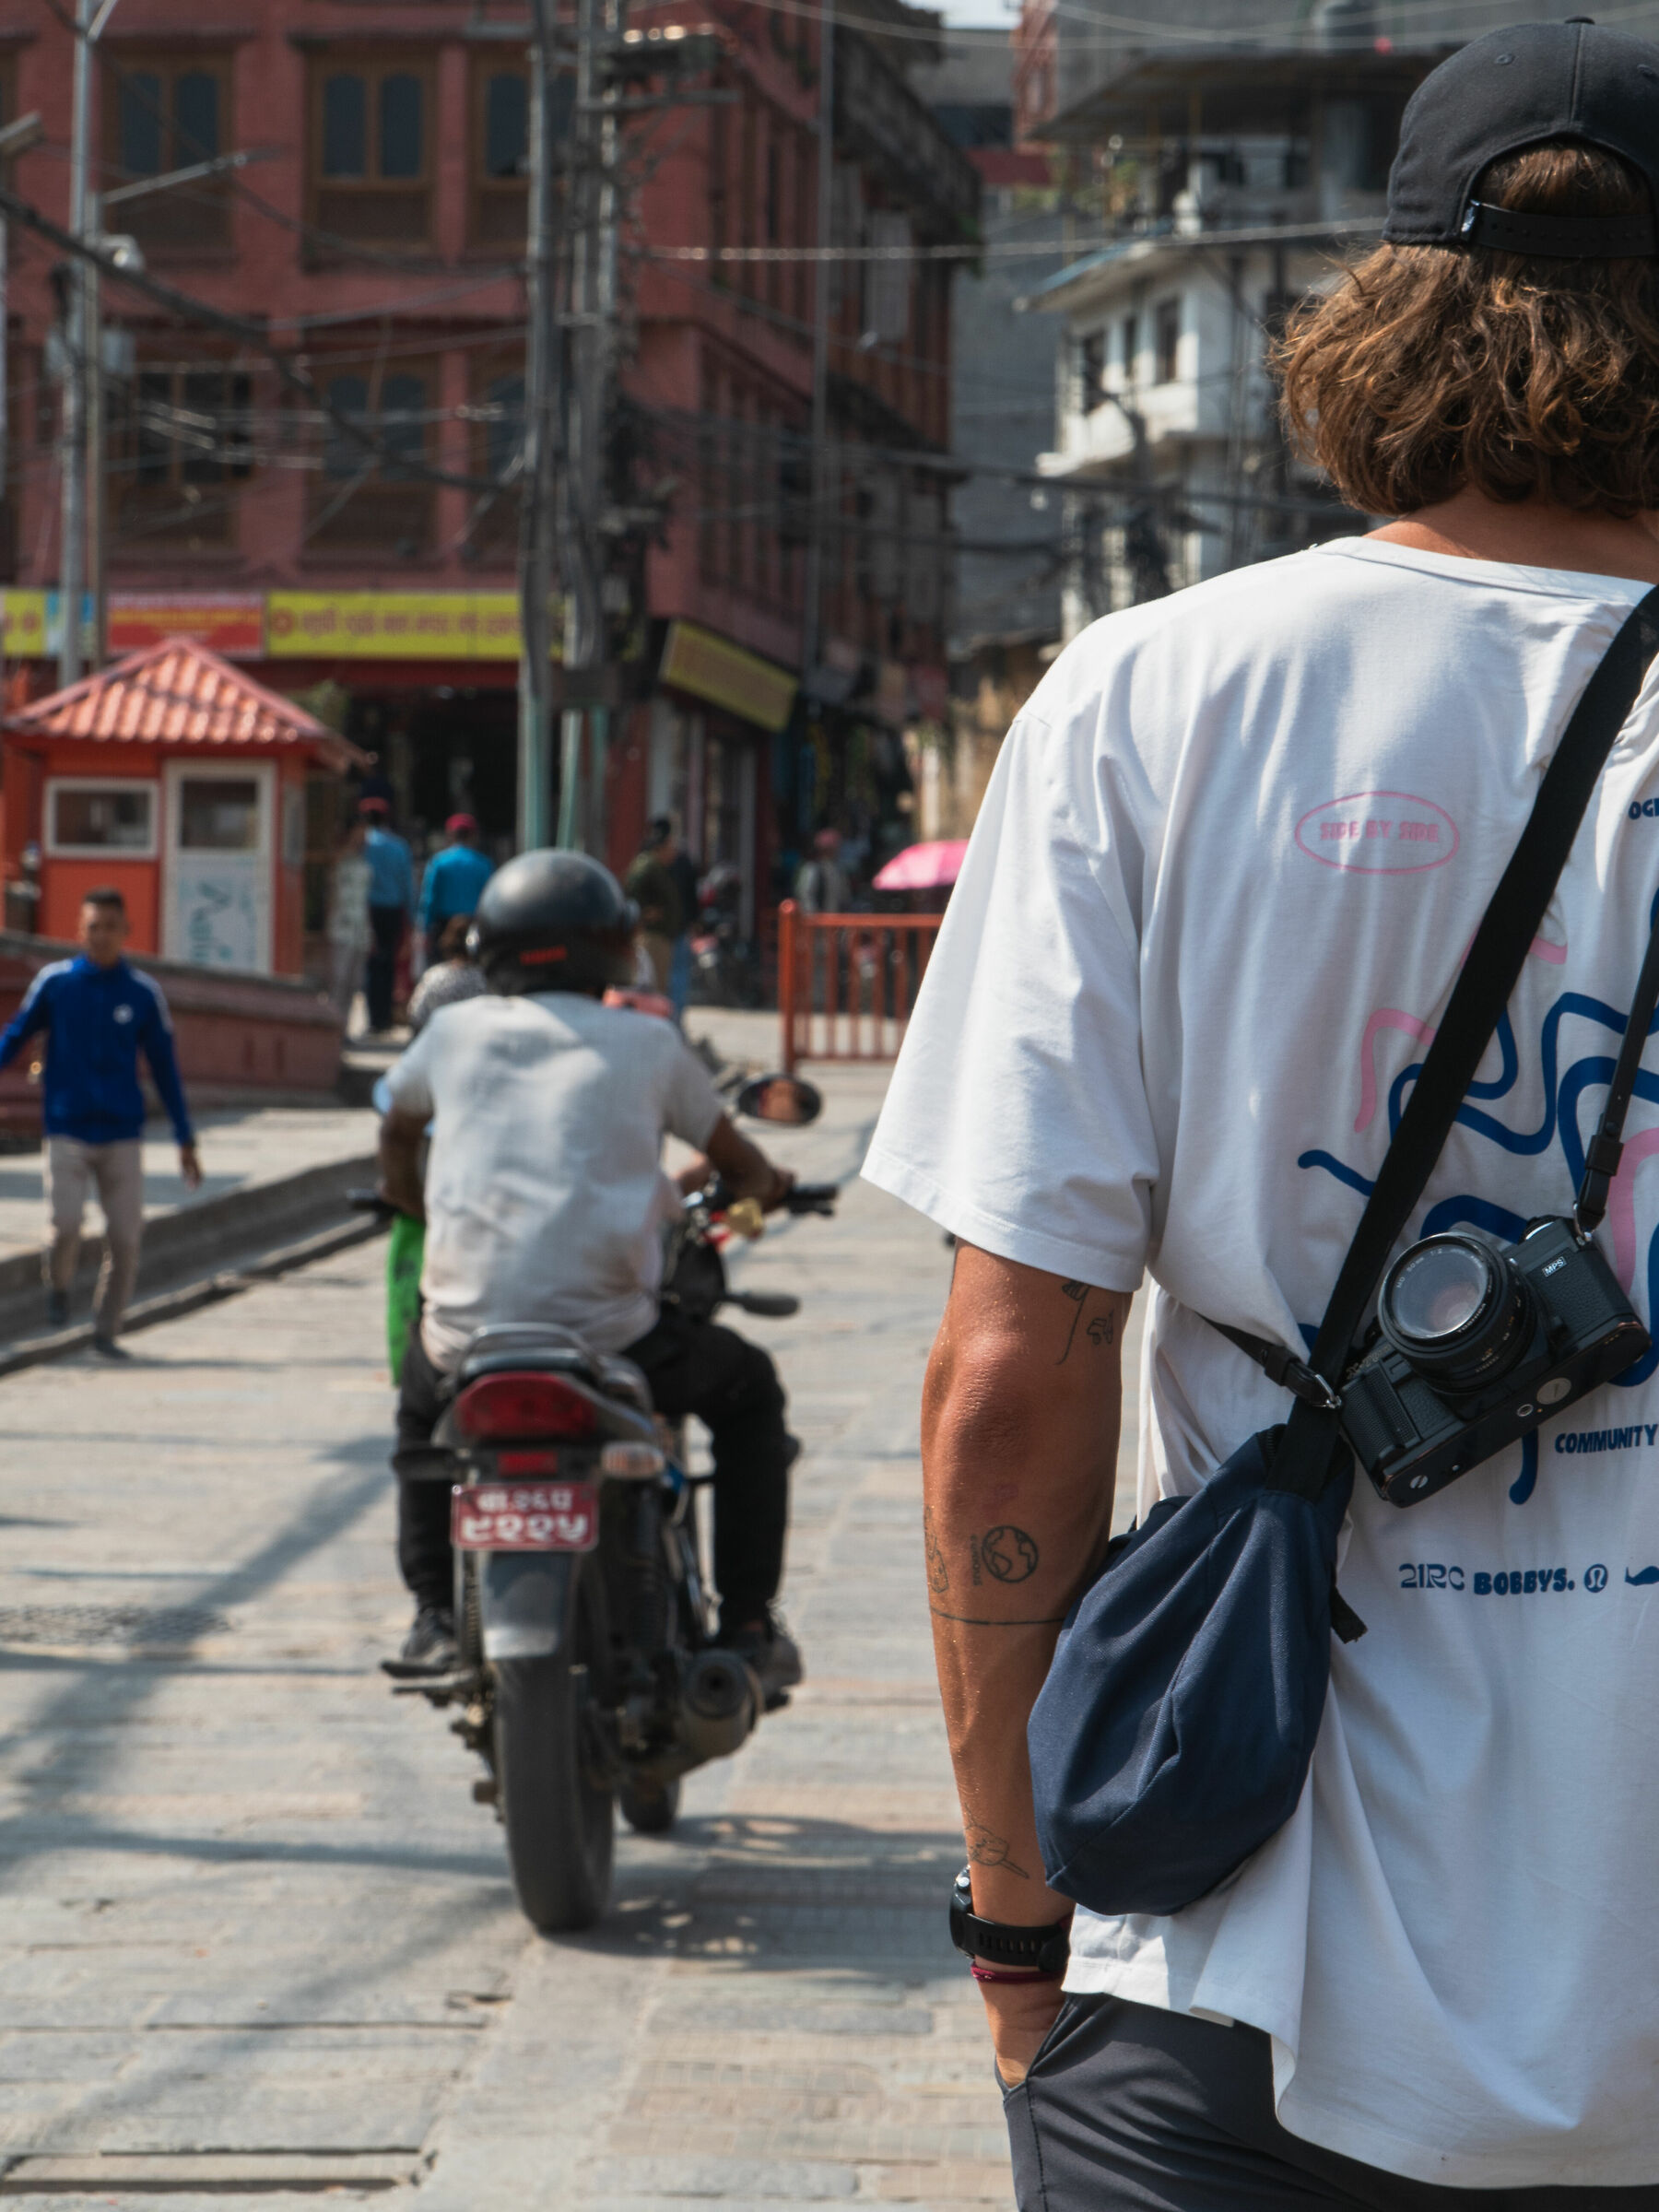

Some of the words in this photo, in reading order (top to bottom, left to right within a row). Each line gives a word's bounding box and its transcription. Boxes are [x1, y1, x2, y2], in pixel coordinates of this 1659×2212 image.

[1320, 821, 1359, 841] SIDE
[1366, 820, 1393, 839] BY
[1399, 822, 1439, 842] SIDE
[1544, 1258, 1564, 1275] MPS
[1554, 1423, 1658, 1454] COMMUNITY
[1474, 1567, 1576, 1595] BOBBYS.
